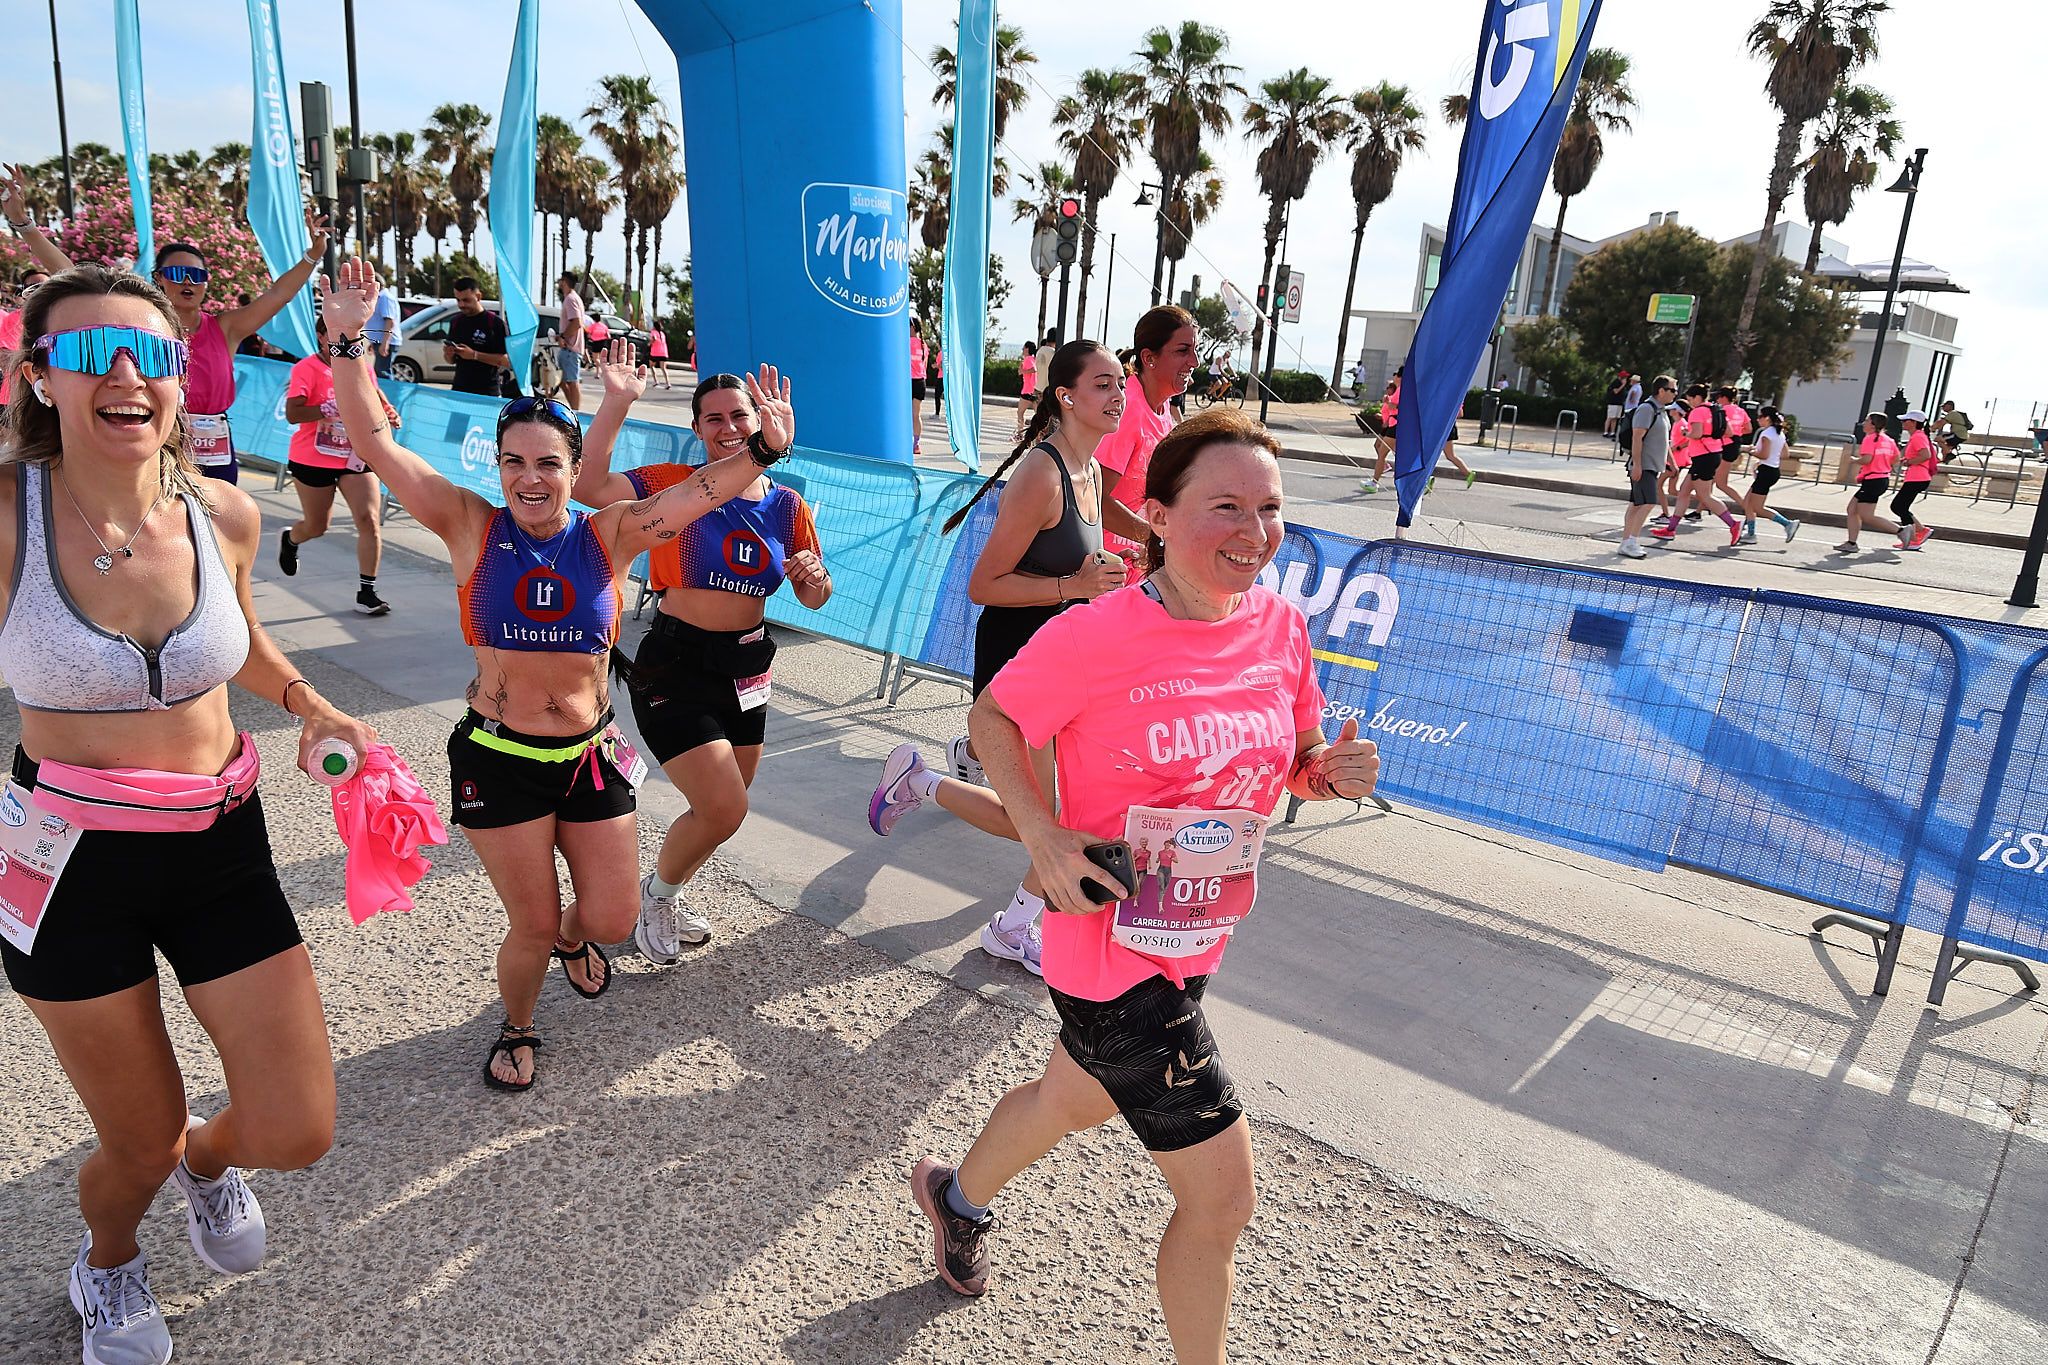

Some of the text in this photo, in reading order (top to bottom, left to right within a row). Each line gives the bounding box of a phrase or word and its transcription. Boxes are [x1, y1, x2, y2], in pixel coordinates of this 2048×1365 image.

[816, 214, 907, 280] Marlene
[824, 276, 849, 300] HIJA
[852, 293, 867, 306] DE
[869, 297, 887, 308] LOS
[194, 438, 216, 447] 016
[708, 571, 766, 597] Litotúria
[502, 622, 583, 642] Litotúria
[1129, 678, 1197, 703] OYSHO
[1368, 699, 1468, 747] bueno!
[1145, 708, 1288, 765] CARRERA
[1141, 820, 1174, 832] SUMA
[1180, 831, 1230, 845] ASTURIANA
[1977, 831, 2048, 873] ¡S
[1173, 876, 1222, 903] 016
[1132, 916, 1168, 928] CARRERA
[1169, 920, 1181, 929] DE
[1181, 921, 1190, 929] LA
[1191, 918, 1212, 928] MUJER
[1189, 907, 1206, 918] 250
[1130, 933, 1181, 949] OYSHO
